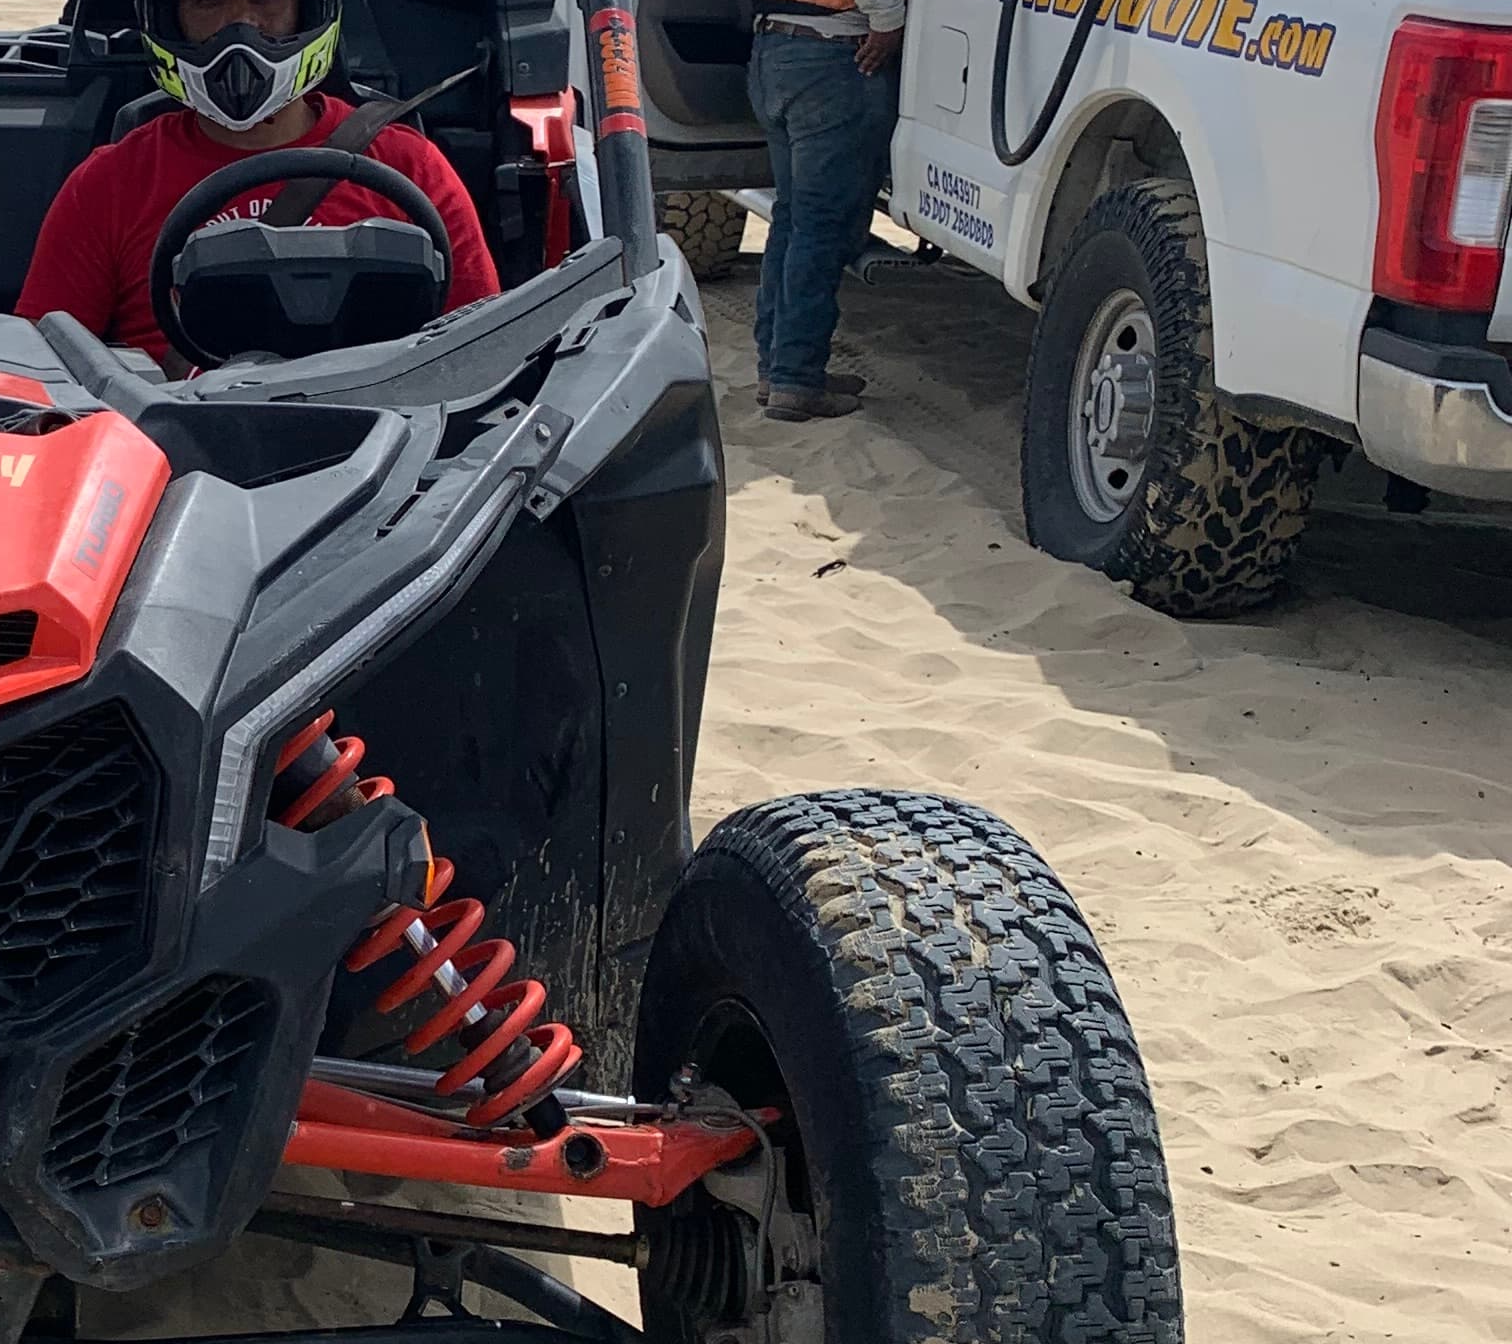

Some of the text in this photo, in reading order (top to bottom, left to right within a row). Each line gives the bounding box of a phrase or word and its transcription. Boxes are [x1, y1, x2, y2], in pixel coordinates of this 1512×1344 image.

[918, 189, 932, 217] US
[931, 197, 951, 227] DOT
[927, 163, 981, 210] CA 0343977
[74, 480, 126, 569] TURBO
